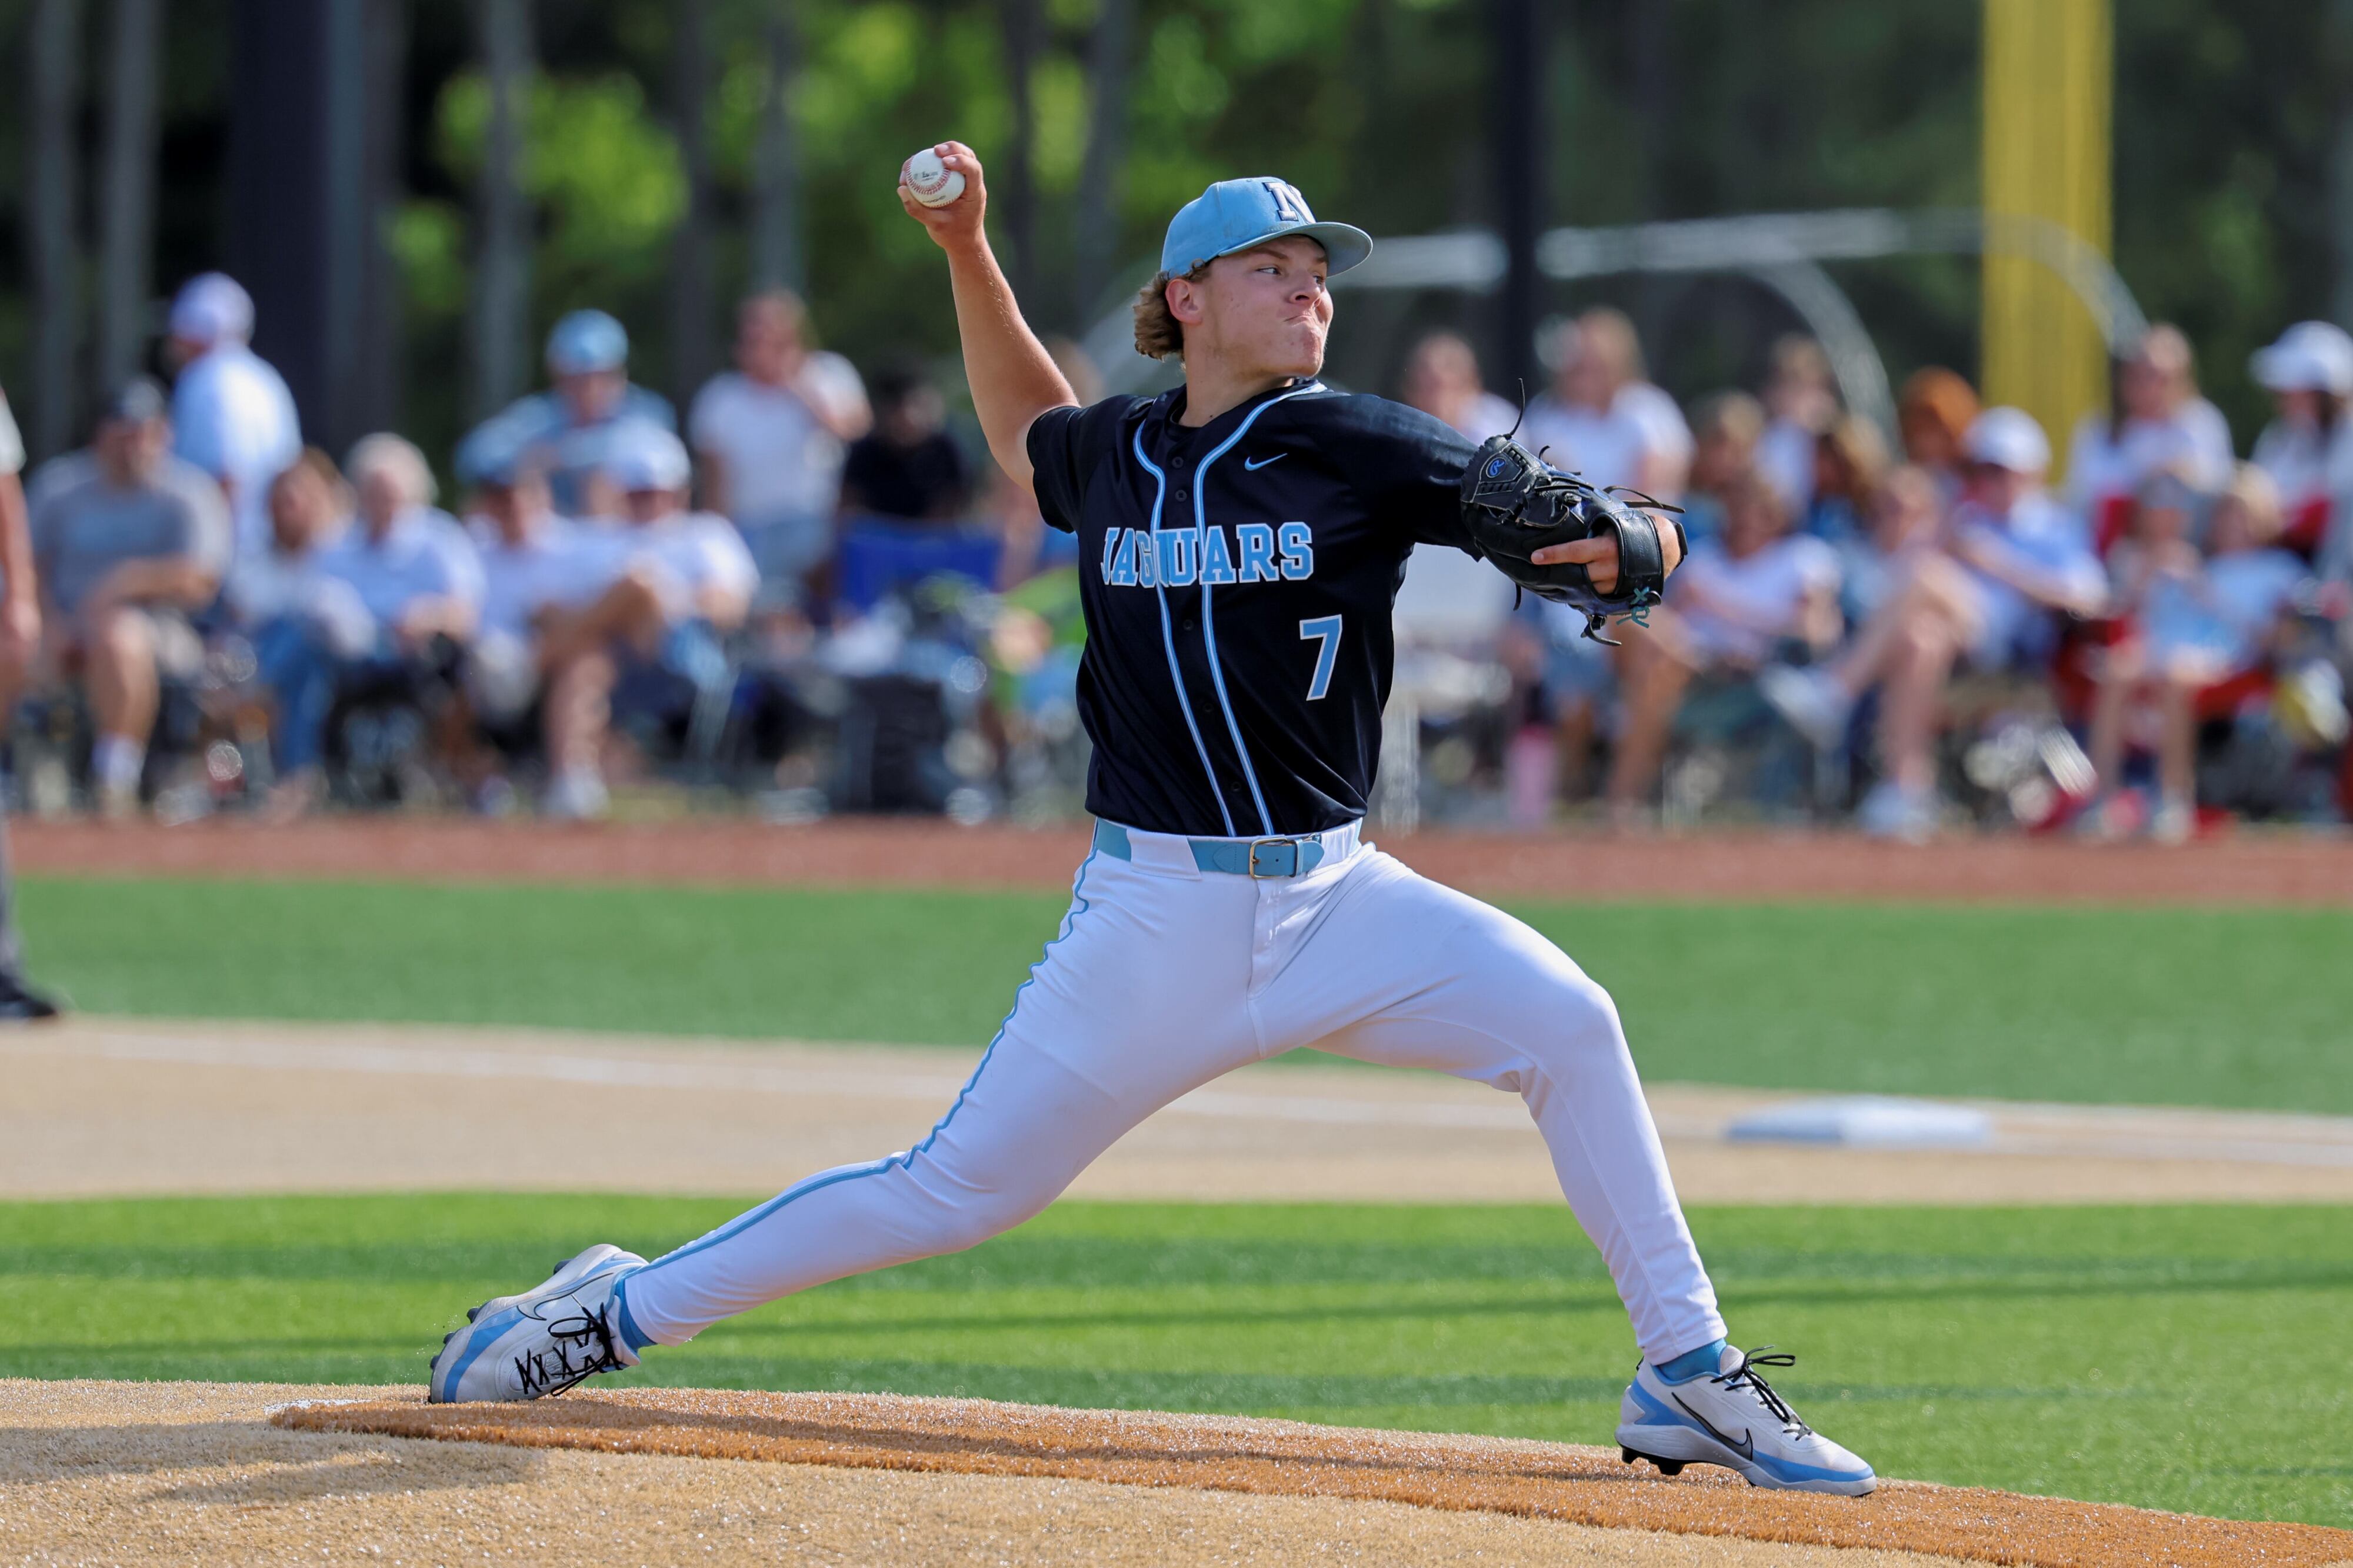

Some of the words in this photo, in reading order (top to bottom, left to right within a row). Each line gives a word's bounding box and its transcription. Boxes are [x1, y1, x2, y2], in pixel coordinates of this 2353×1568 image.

[1261, 182, 1317, 224] N
[1101, 521, 1314, 588] JAGUARS
[1299, 614, 1342, 701] 7
